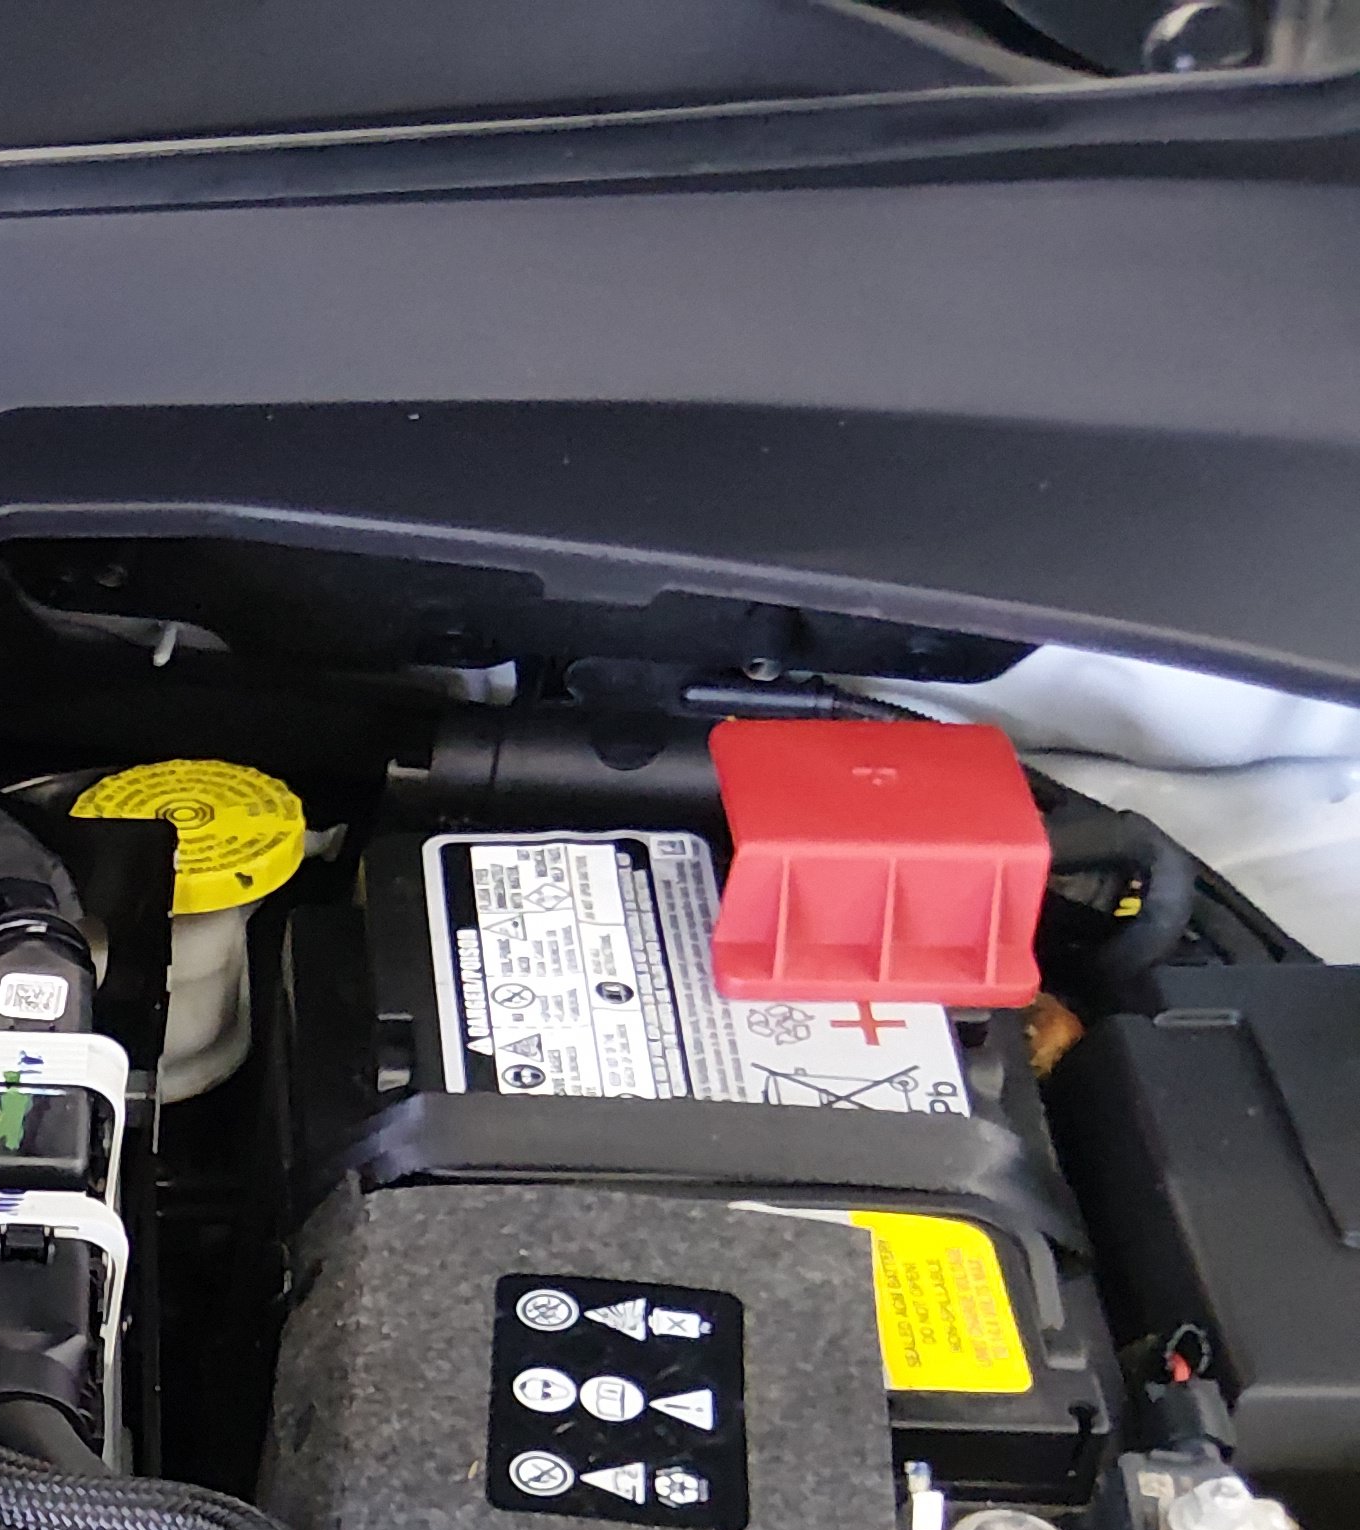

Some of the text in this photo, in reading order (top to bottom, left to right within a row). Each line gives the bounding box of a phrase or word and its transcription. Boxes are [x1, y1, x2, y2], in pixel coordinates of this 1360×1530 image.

[456, 929, 491, 1037] DANGER/POISON
[927, 1080, 960, 1114] Pb
[878, 1239, 922, 1368] SEALED AGM BATTERY
[912, 1300, 929, 1323] NOT
[919, 1326, 936, 1345] DO
[926, 1259, 962, 1353] NON-SPILLABLE
